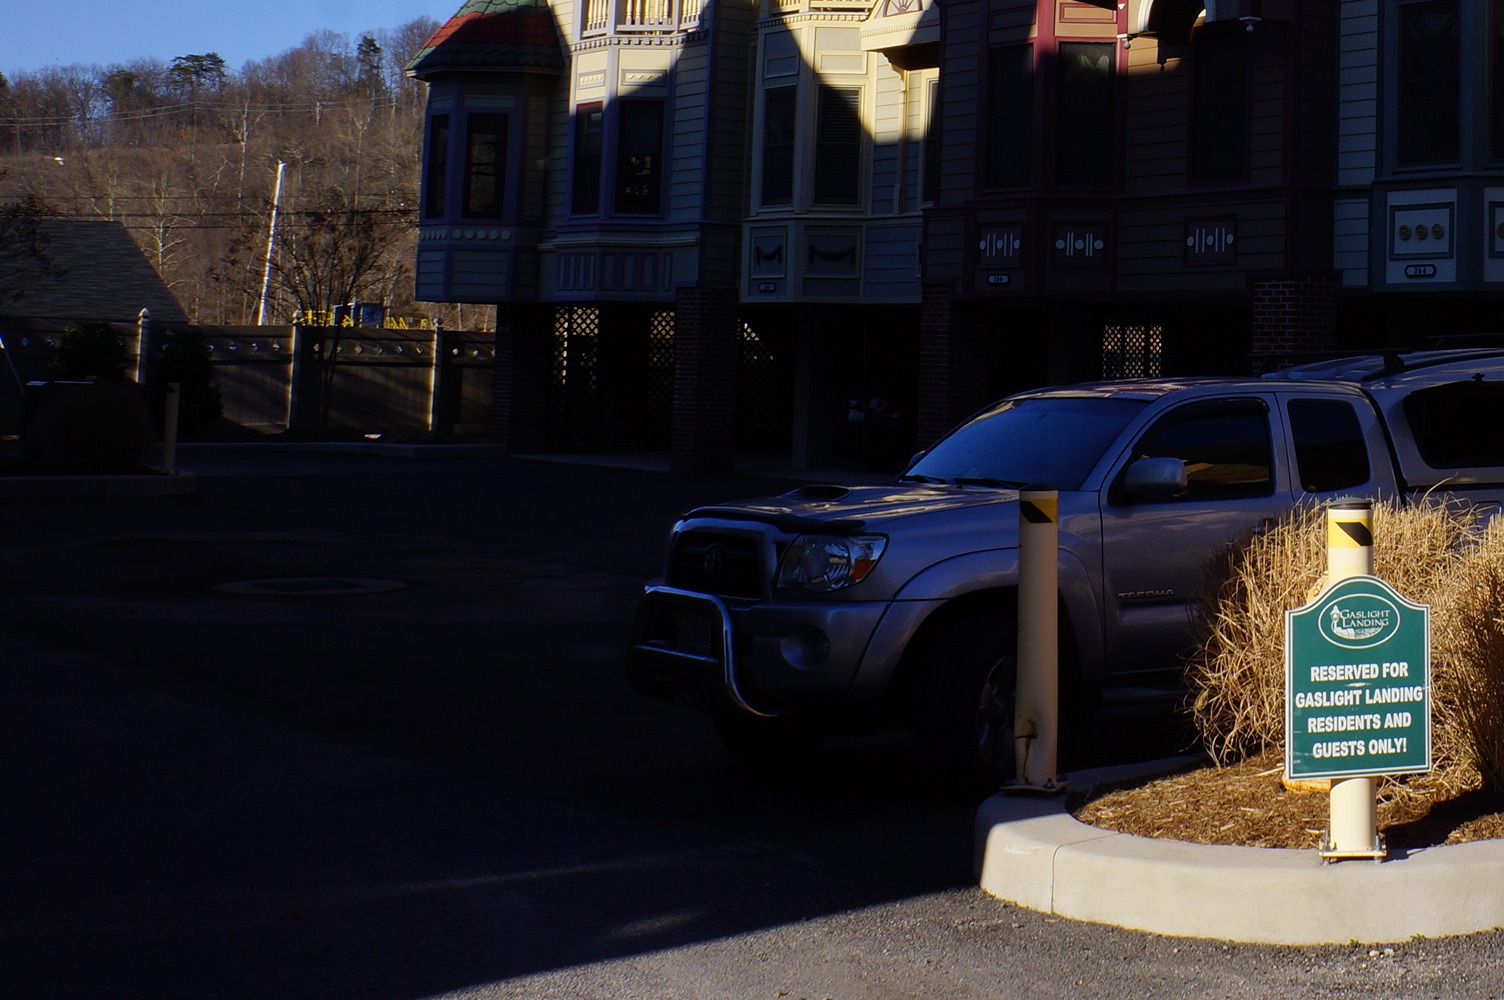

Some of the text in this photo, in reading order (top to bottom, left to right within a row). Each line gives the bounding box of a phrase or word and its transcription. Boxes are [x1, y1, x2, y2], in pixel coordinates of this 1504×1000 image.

[1118, 589, 1174, 598] TACOMA
[1340, 609, 1390, 618] GASLIGHT
[1342, 618, 1389, 628] LANDING
[1310, 662, 1409, 682] RESERVED FOR
[1295, 686, 1423, 708] GASLIGHT LANDING
[1307, 712, 1412, 733] RESIDENTS AND
[1312, 737, 1407, 758] GUESTS ONLY!
